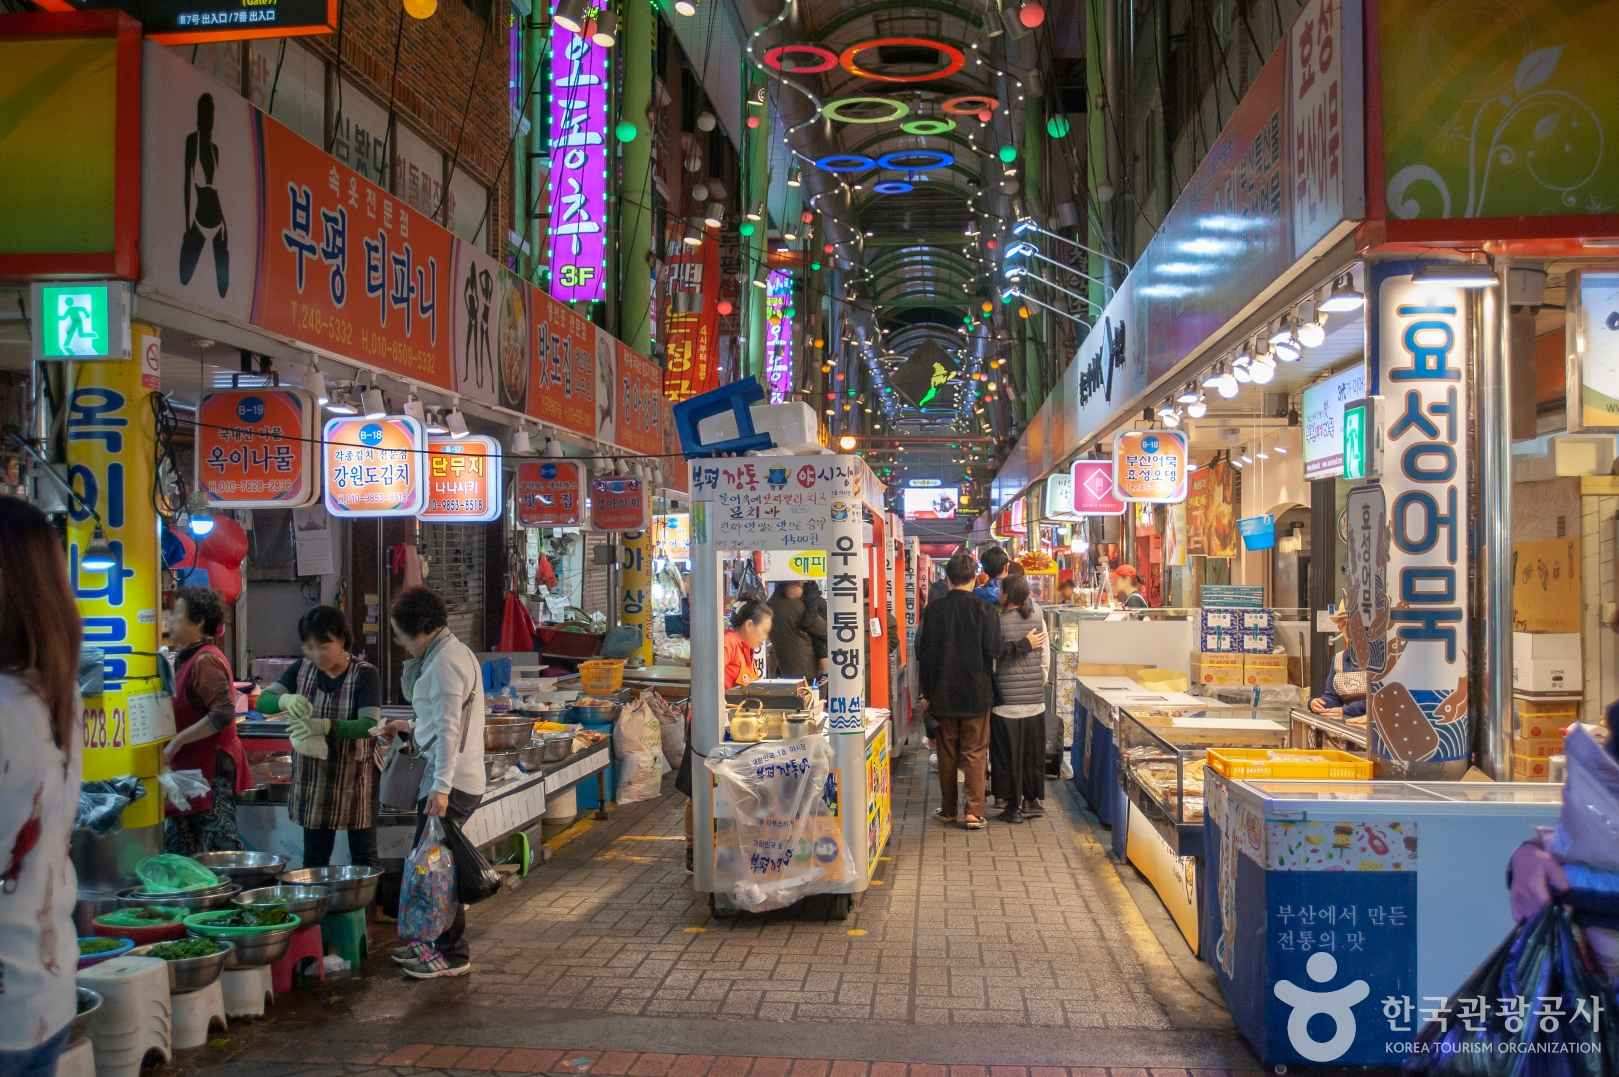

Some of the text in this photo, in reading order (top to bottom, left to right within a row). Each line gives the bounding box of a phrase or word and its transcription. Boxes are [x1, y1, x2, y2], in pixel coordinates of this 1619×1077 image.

[282, 181, 347, 309] 부평
[363, 227, 438, 347] 티파니
[559, 264, 596, 288] 3F
[360, 431, 382, 440] B-18
[207, 445, 294, 473] 옥이나물
[335, 449, 374, 462] 각종김치
[432, 456, 483, 477] 단무지
[1127, 455, 1177, 467] 부산어묵
[335, 463, 409, 488] 강원도김치
[692, 465, 720, 492] 부평
[1125, 469, 1177, 482] 효성오뎅
[1387, 304, 1462, 663] 효성어묵
[1361, 505, 1373, 621] 효성어묵
[831, 536, 858, 680] 우측통행
[830, 696, 861, 714] 대선
[1275, 904, 1409, 927] 부산에서 만든
[1277, 930, 1367, 952] 전통의 맛
